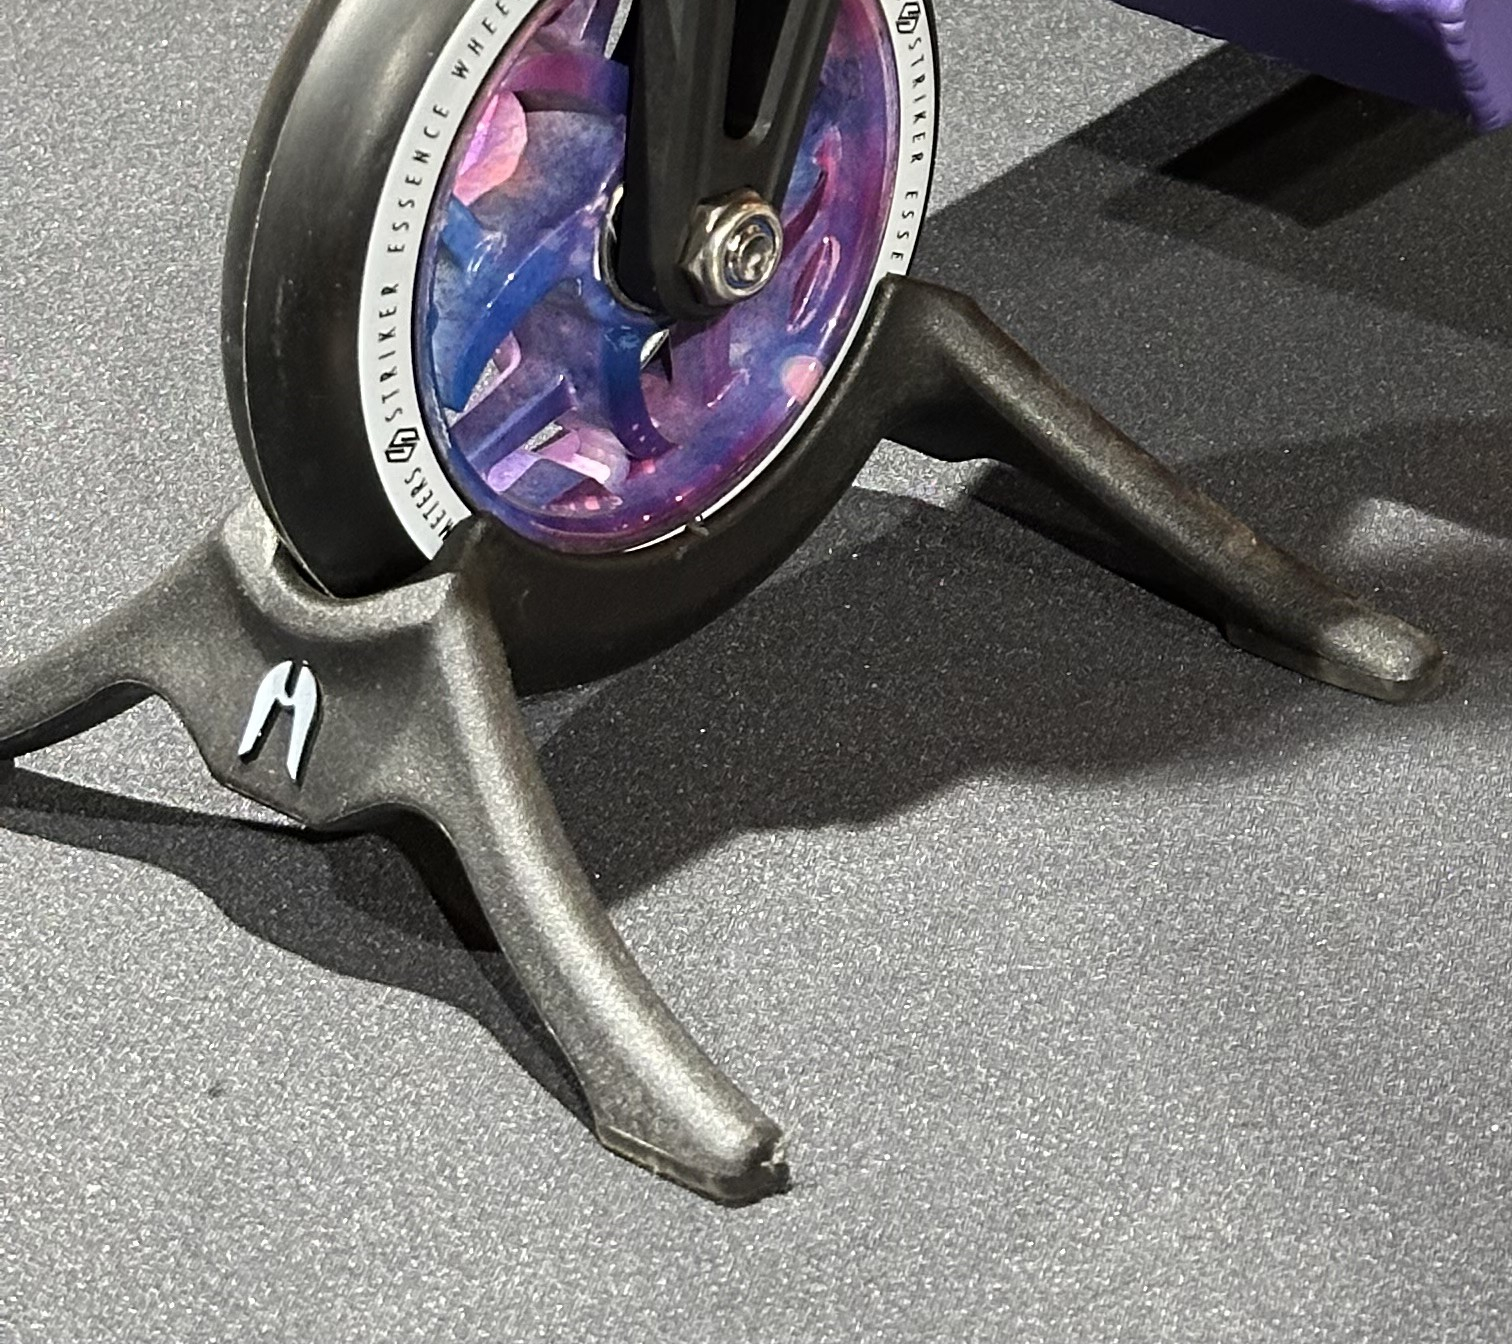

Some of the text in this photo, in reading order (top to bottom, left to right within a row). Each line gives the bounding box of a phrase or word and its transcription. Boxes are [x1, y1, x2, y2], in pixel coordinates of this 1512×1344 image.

[387, 103, 449, 254] ESSENCE
[890, 36, 928, 262] STRIKER ESSE
[378, 282, 404, 425] STRIKER
[403, 466, 455, 542] METERS
